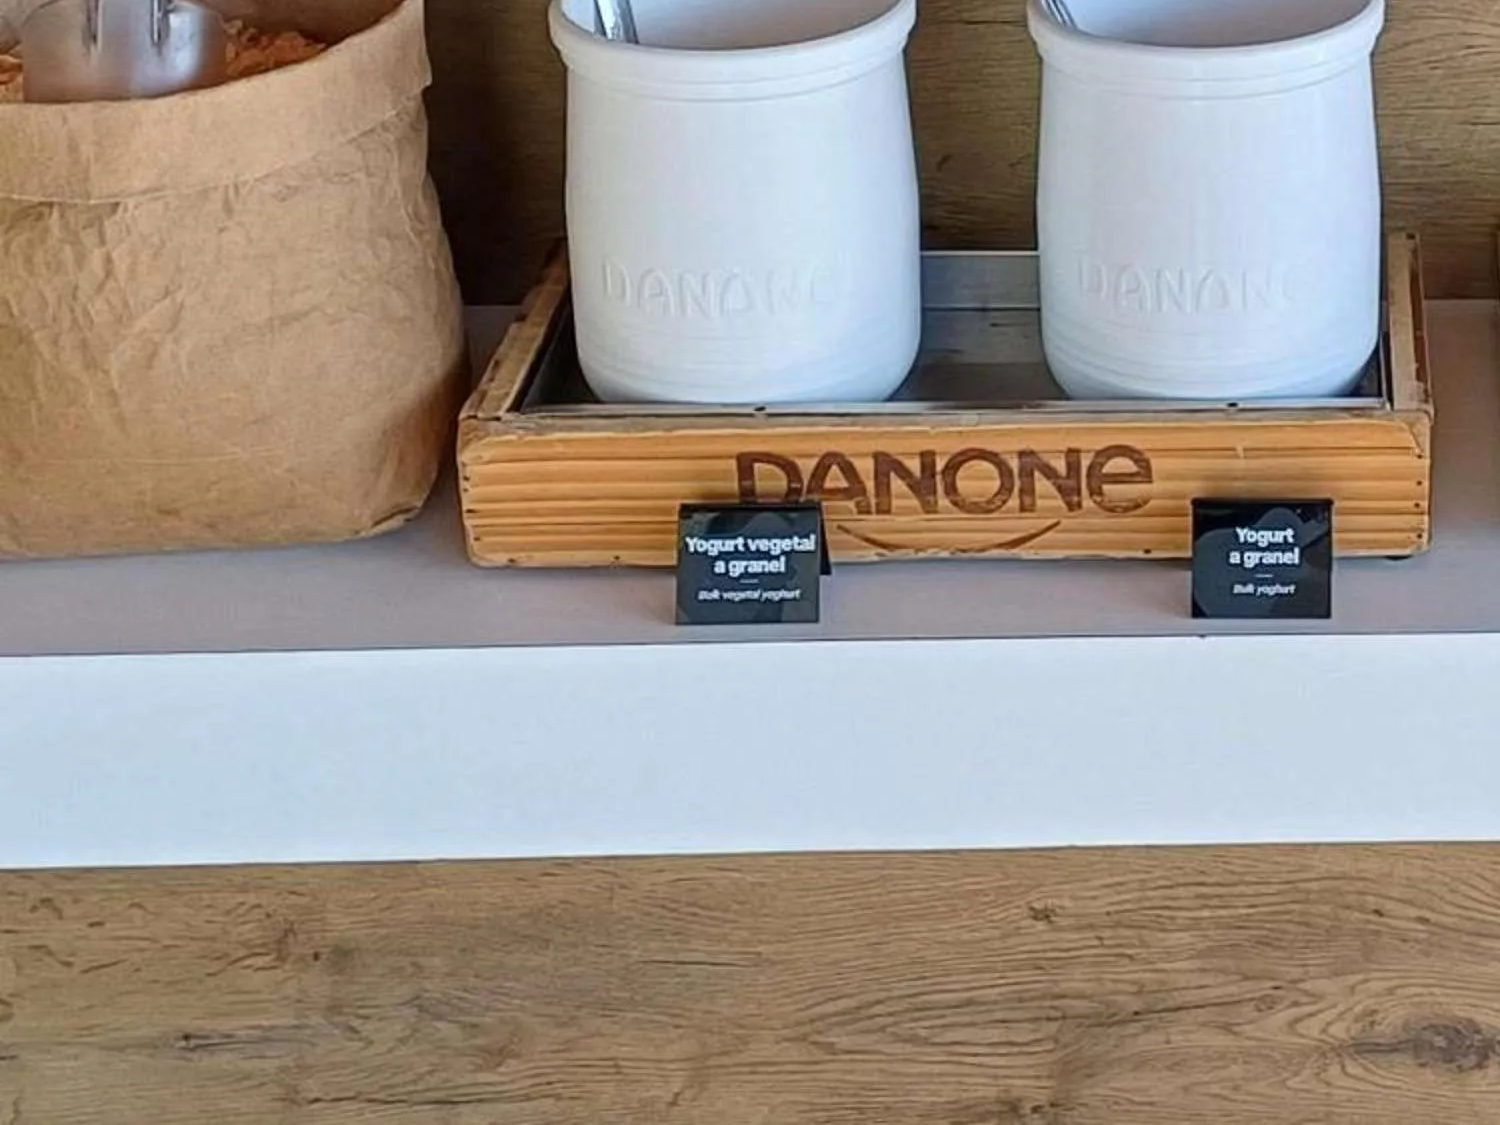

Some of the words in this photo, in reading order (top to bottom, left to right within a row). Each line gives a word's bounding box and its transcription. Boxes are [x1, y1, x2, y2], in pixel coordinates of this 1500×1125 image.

[685, 536, 745, 556] Yogurt
[746, 533, 816, 556] vegetal
[1235, 526, 1294, 547] Yogurt
[713, 559, 726, 574] a
[727, 555, 786, 577] granel
[1228, 551, 1241, 564] a
[1243, 546, 1299, 568] granel
